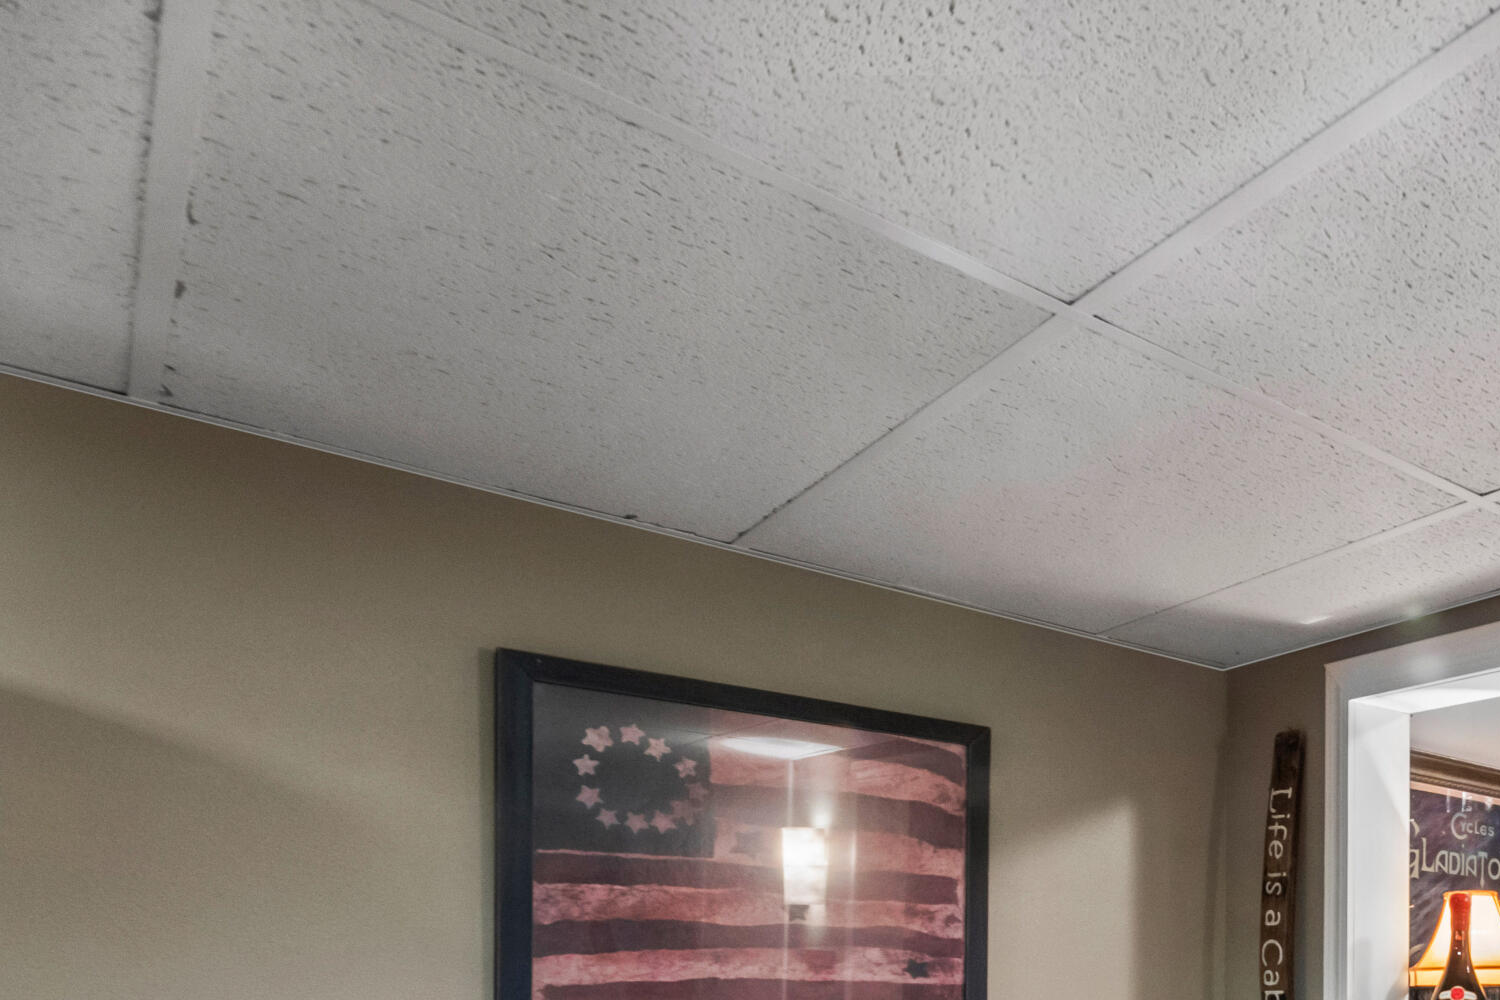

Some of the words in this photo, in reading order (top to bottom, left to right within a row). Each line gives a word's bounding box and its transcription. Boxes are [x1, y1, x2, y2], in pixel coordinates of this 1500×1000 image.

[1267, 786, 1293, 859] Life
[1451, 813, 1495, 840] Cycles
[1264, 871, 1288, 896] is
[1263, 908, 1282, 927] a
